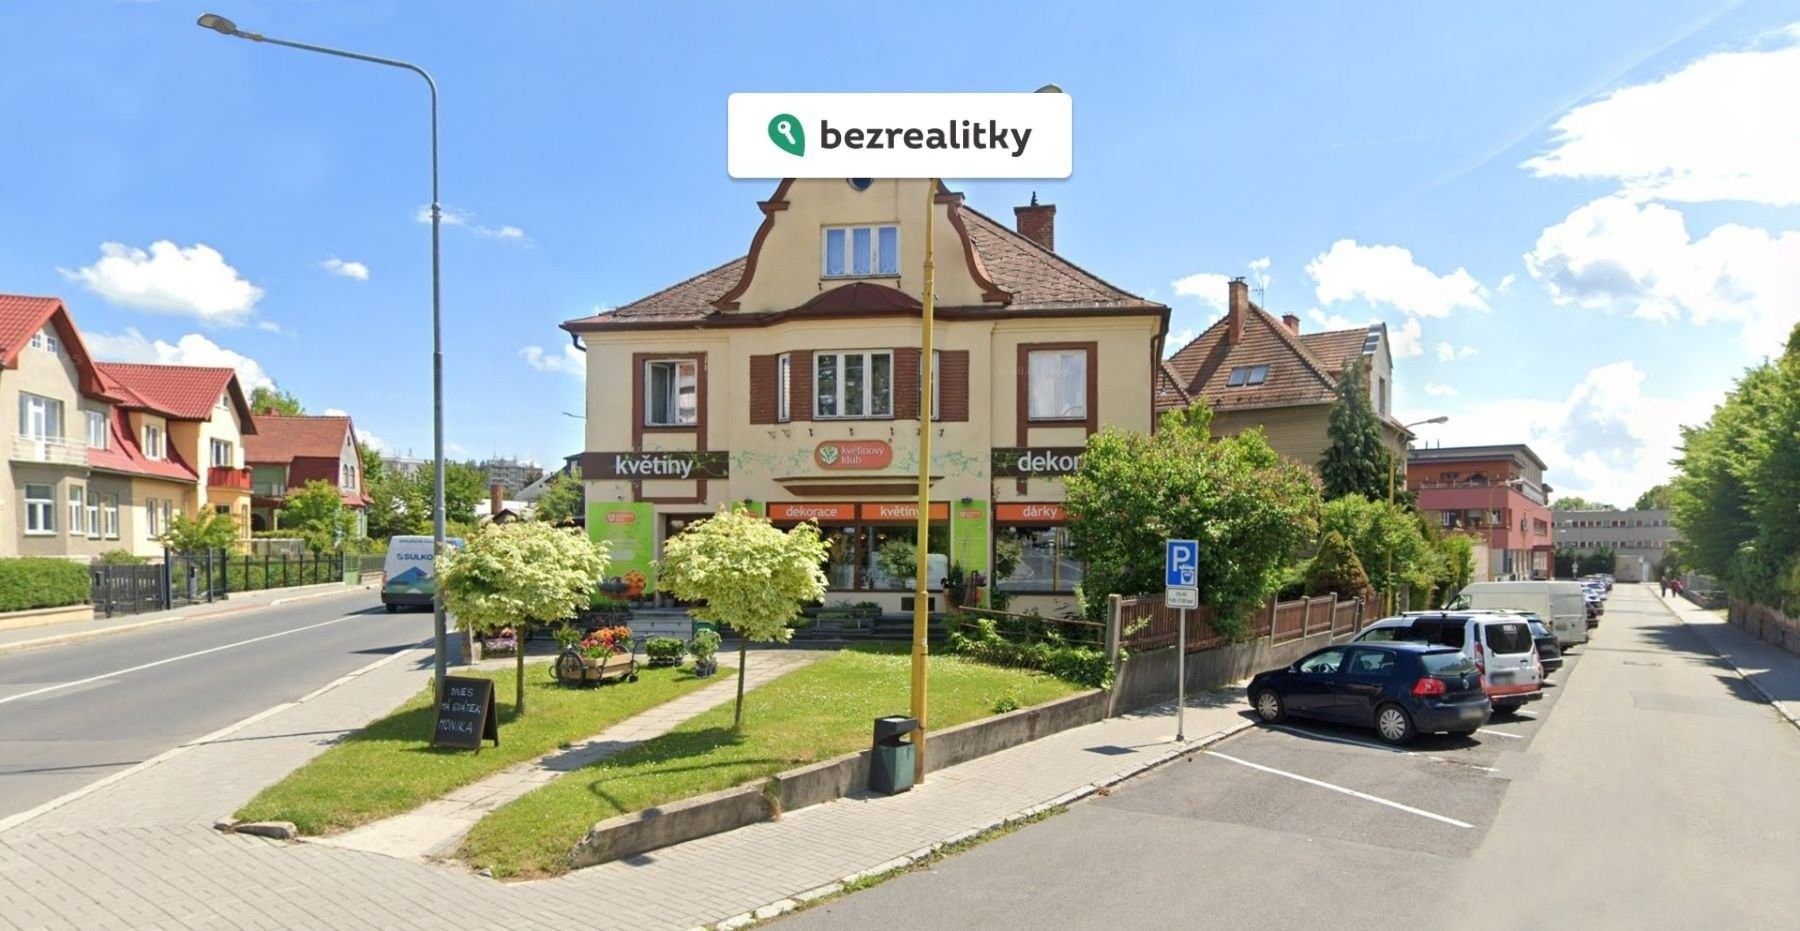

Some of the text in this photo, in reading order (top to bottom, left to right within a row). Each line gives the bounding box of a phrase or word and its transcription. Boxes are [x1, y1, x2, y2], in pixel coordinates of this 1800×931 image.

[615, 454, 694, 480] květiny
[841, 455, 863, 465] klub
[1017, 450, 1079, 472] dekor
[785, 505, 838, 517] dekorace
[1023, 505, 1058, 519] dárky
[1172, 545, 1191, 572] P
[450, 687, 475, 697] DNES
[438, 718, 473, 734] MONIKA
